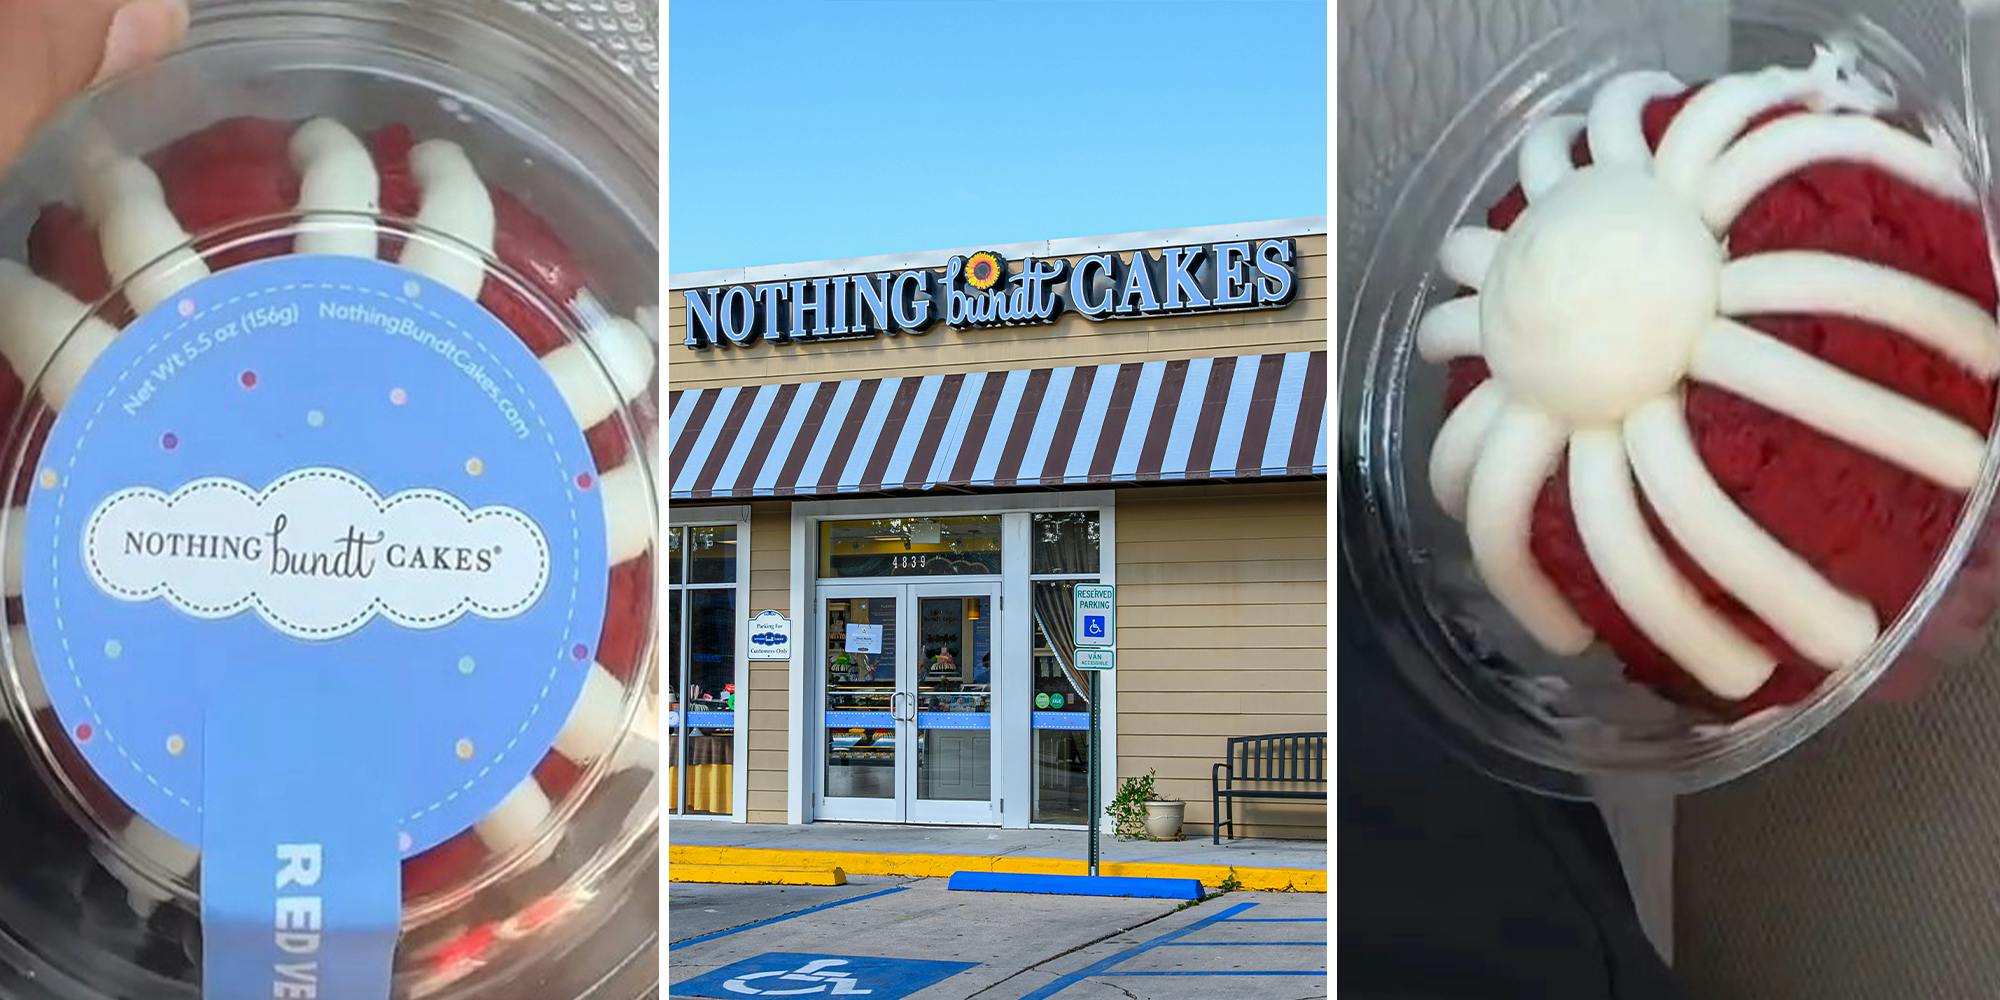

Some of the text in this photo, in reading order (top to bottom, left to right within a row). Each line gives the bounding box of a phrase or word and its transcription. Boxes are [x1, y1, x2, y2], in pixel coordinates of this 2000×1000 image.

[683, 239, 1292, 346] NOTHING bundt CAKES
[122, 302, 299, 416] Net Wt 5.5 oz (156g)
[319, 302, 530, 439] NothingBundtCakes.com
[123, 531, 262, 561] NOTHING
[265, 513, 385, 579] bundt
[892, 555, 926, 569] 4839
[1077, 590, 1112, 599] RESERVED
[1079, 600, 1110, 610] PARKING
[274, 843, 322, 954] RED
